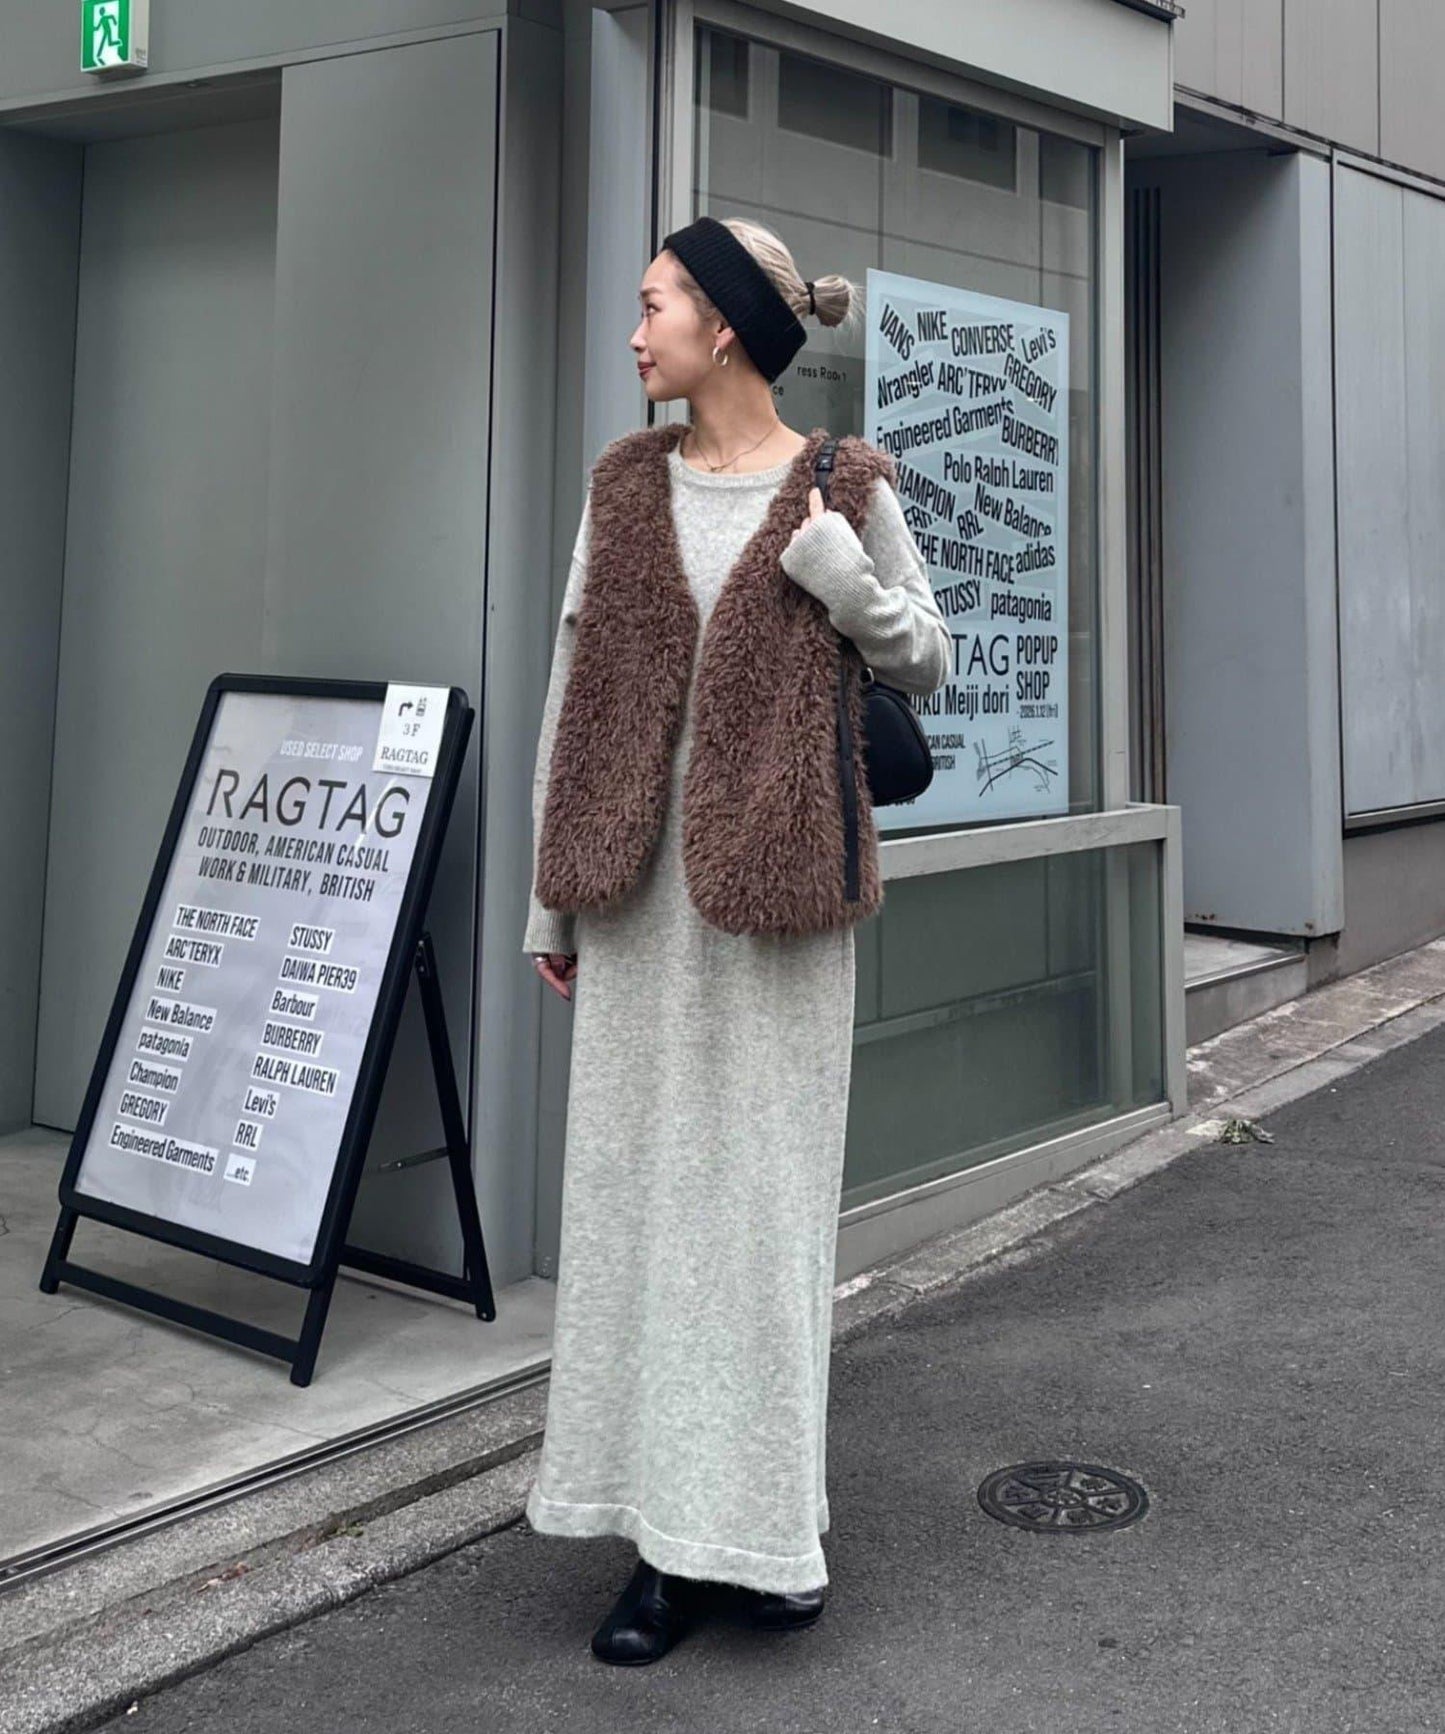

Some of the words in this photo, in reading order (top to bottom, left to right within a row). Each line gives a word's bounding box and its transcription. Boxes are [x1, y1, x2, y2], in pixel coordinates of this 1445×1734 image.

[879, 303, 914, 361] VANS
[917, 311, 948, 342] NIKE
[951, 324, 1015, 357] CONVERSE
[1021, 327, 1056, 364] Levi's
[1003, 353, 1057, 413] GREGORY
[876, 408, 952, 459] Engineered
[952, 396, 1015, 436] Garments
[944, 452, 971, 484] Polo
[974, 456, 1009, 488] Ralph
[1012, 460, 1054, 493] Lauren
[895, 461, 956, 522] HAMPION
[957, 509, 984, 540] RRL
[974, 482, 1003, 522] New
[1004, 497, 1052, 539] Balance
[913, 531, 938, 565] THE
[940, 539, 984, 578] NORTH
[985, 550, 1015, 585] FACE
[1016, 541, 1056, 574] adidas
[934, 578, 980, 618] STUSSY
[990, 589, 1052, 624] patagonia
[1016, 635, 1058, 665] POPUP
[1016, 670, 1050, 701] SHOP
[945, 684, 979, 721] Meiji
[982, 685, 1010, 716] dori
[304, 742, 338, 760] SELECT
[338, 744, 364, 762] SHOP
[380, 746, 429, 766] RAGTAG
[206, 768, 410, 839] RAGTAG
[198, 826, 260, 858] OUTDOOR,
[264, 835, 338, 865] AMERICAN
[336, 844, 389, 872] CASUAL
[198, 856, 236, 881] WORK
[236, 861, 246, 883] &
[248, 862, 312, 896] MILITARY,
[319, 872, 376, 902] BRITISH
[176, 906, 197, 928] THE
[196, 909, 230, 934] NORTH
[230, 915, 258, 939] FACE
[290, 925, 332, 952] STUSSY
[166, 937, 223, 965] ARC'TERYX
[156, 968, 184, 991] NIKE
[282, 957, 316, 984] DAIWA
[317, 965, 358, 992] PIER39
[147, 999, 170, 1022] New
[170, 1004, 214, 1032] Balance
[272, 990, 316, 1018] Barbour
[138, 1030, 190, 1058] patagonia
[263, 1023, 322, 1055] BURBERRY
[130, 1060, 178, 1092] Champion
[253, 1055, 290, 1082] RALPH
[290, 1063, 337, 1094] LAUREN
[120, 1092, 168, 1123] GREGORY
[244, 1087, 278, 1116] Levi's
[110, 1124, 167, 1158] Engineered
[165, 1139, 214, 1172] Garments
[234, 1122, 258, 1148] RRL
